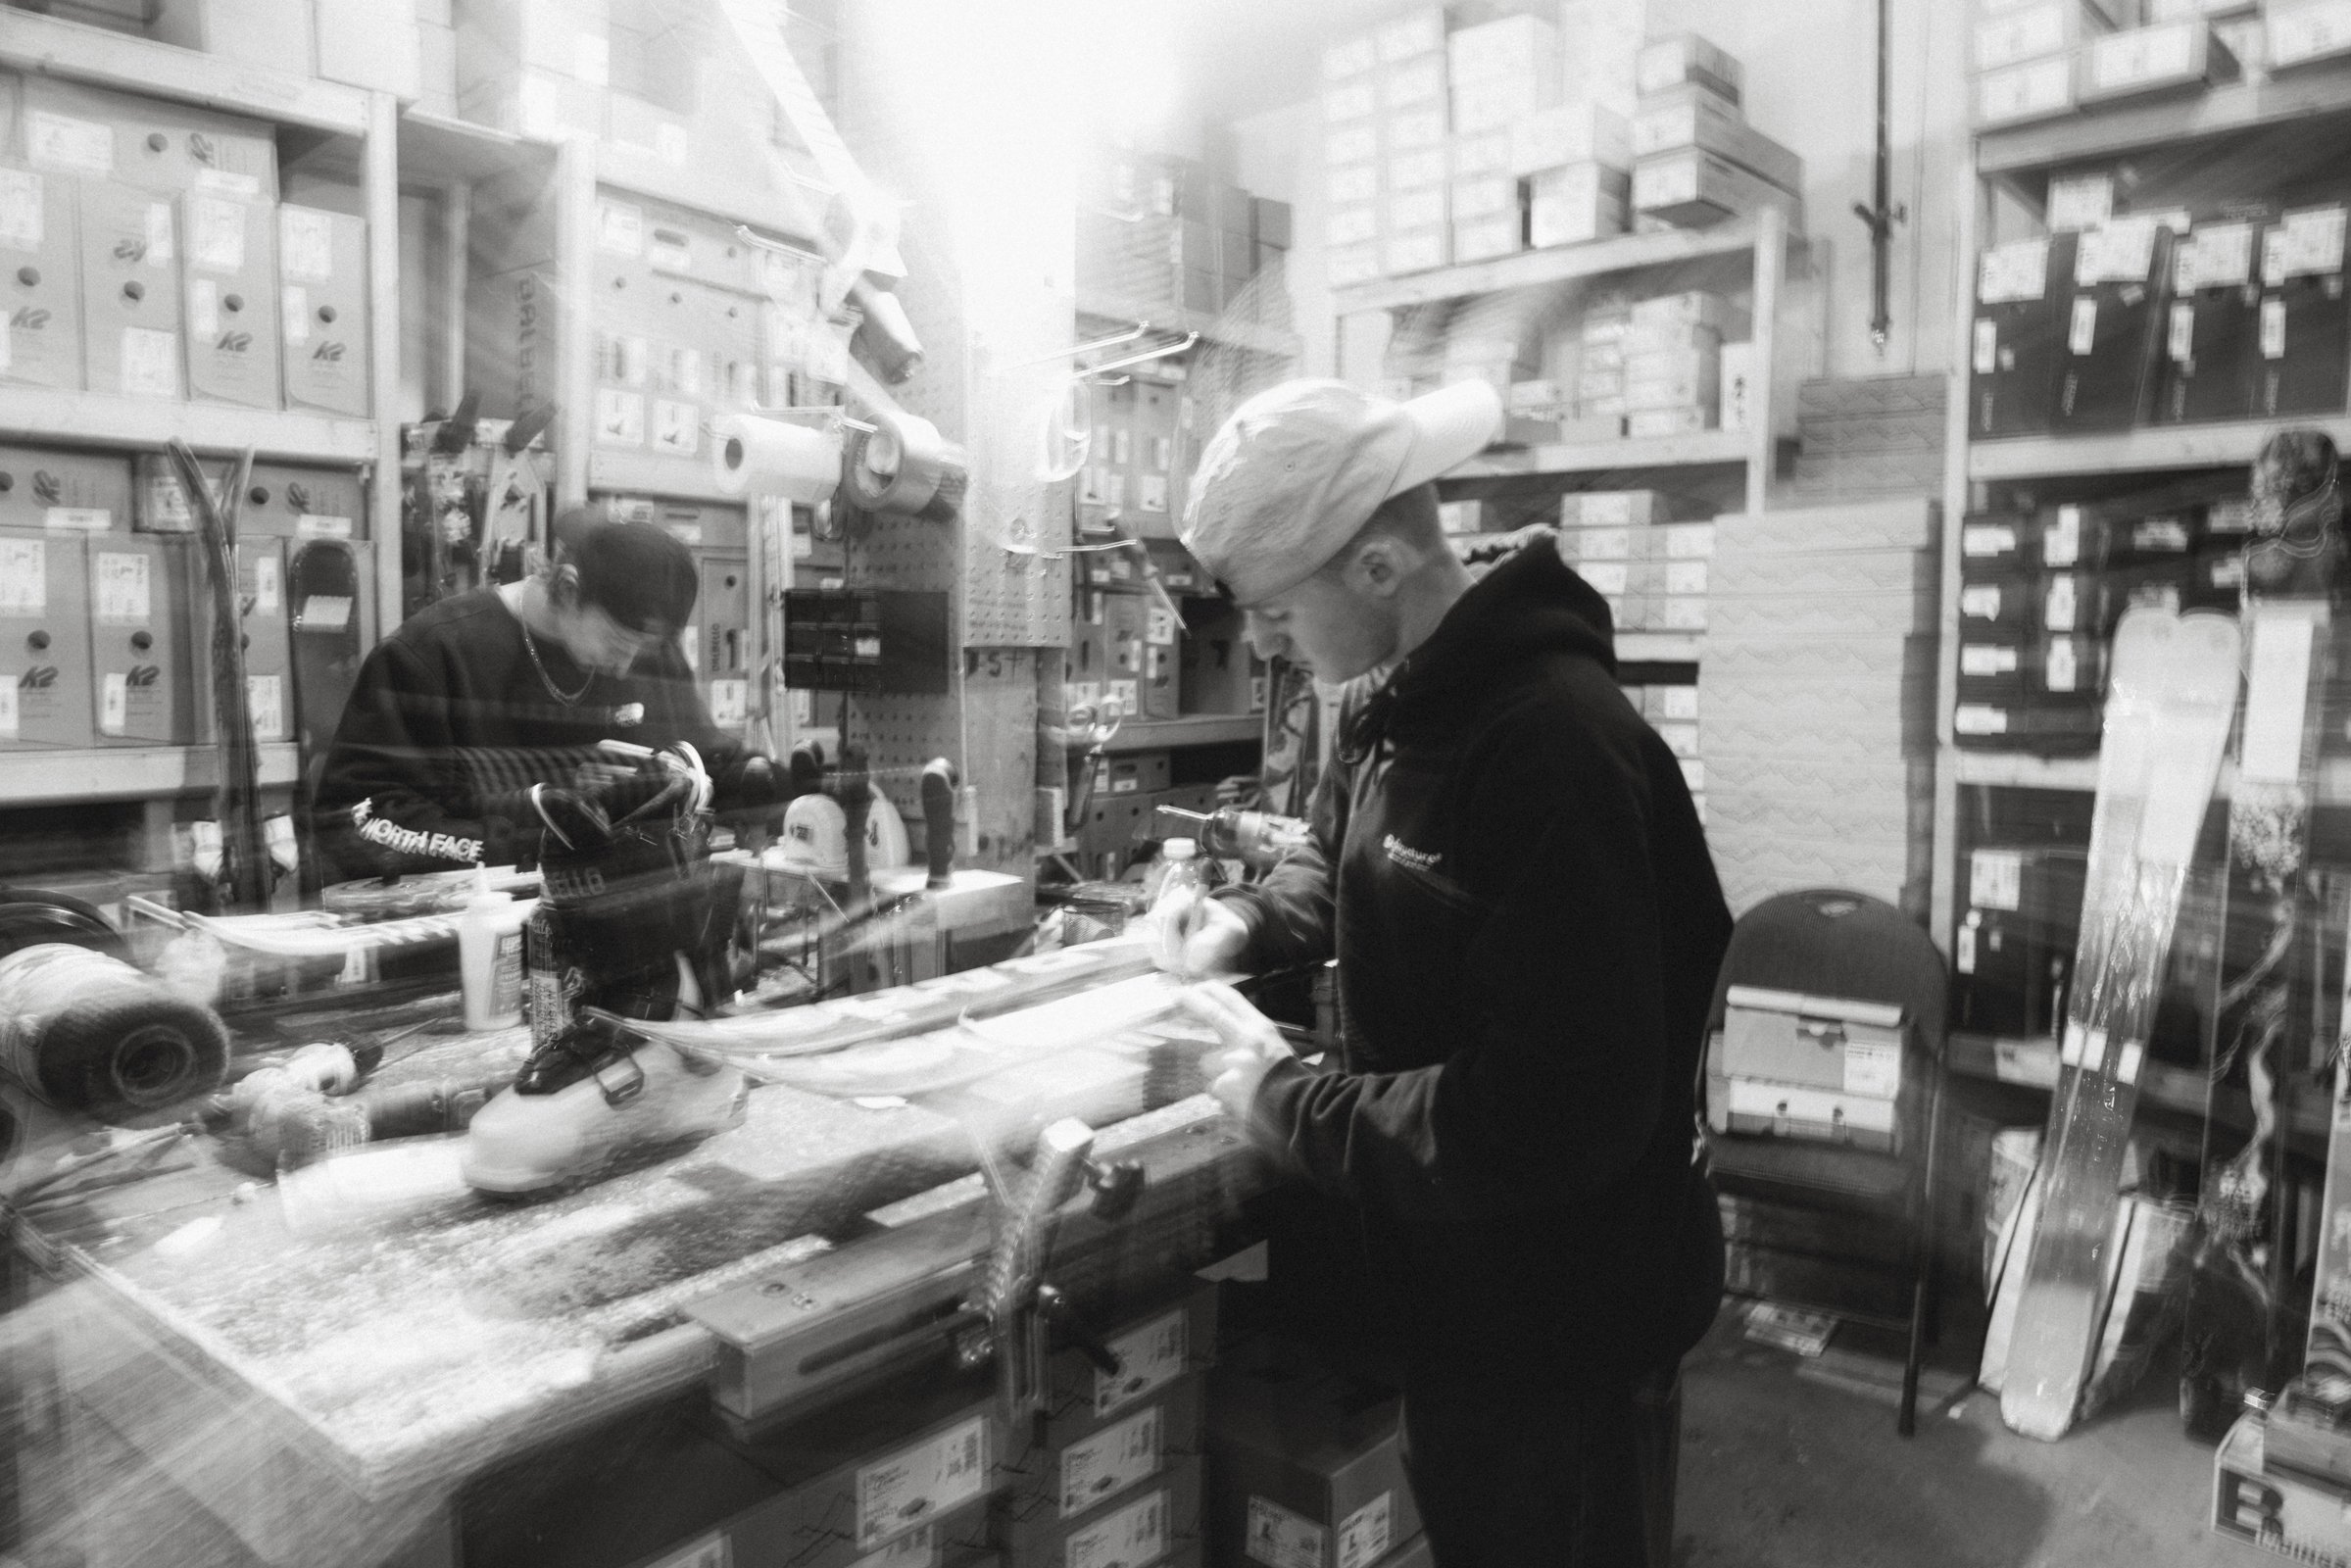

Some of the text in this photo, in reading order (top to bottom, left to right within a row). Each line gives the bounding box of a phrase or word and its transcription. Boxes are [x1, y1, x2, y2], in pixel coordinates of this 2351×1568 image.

[10, 307, 50, 330] K2
[216, 330, 253, 353] K2
[312, 341, 347, 362] K2
[19, 665, 59, 687] K2
[126, 664, 160, 687] K2
[360, 817, 429, 856] NORTH
[428, 832, 485, 863] FACE
